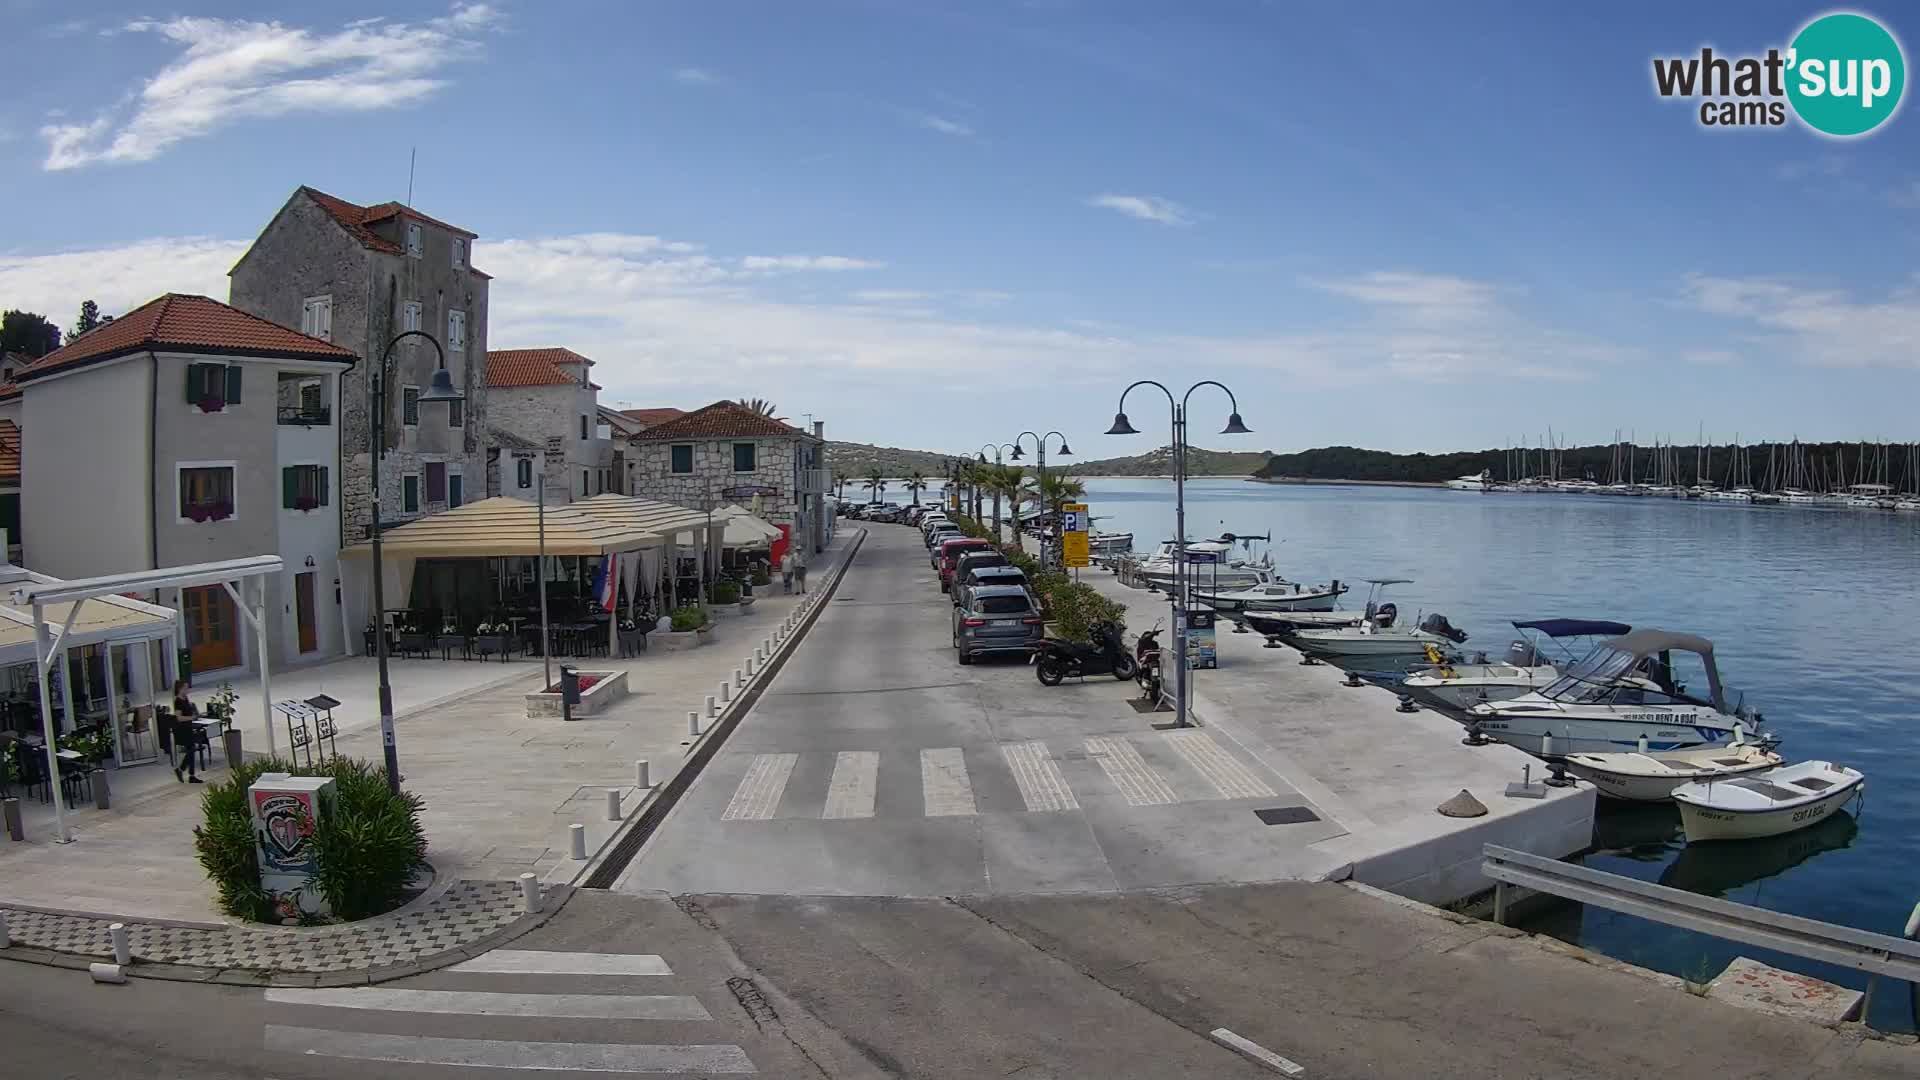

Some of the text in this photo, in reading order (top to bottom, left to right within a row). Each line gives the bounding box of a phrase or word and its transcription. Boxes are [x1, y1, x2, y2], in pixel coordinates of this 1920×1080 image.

[1065, 514, 1075, 529] P
[1655, 714, 1674, 722] RENT
[1675, 714, 1679, 723] A
[1680, 714, 1698, 724] BOAT
